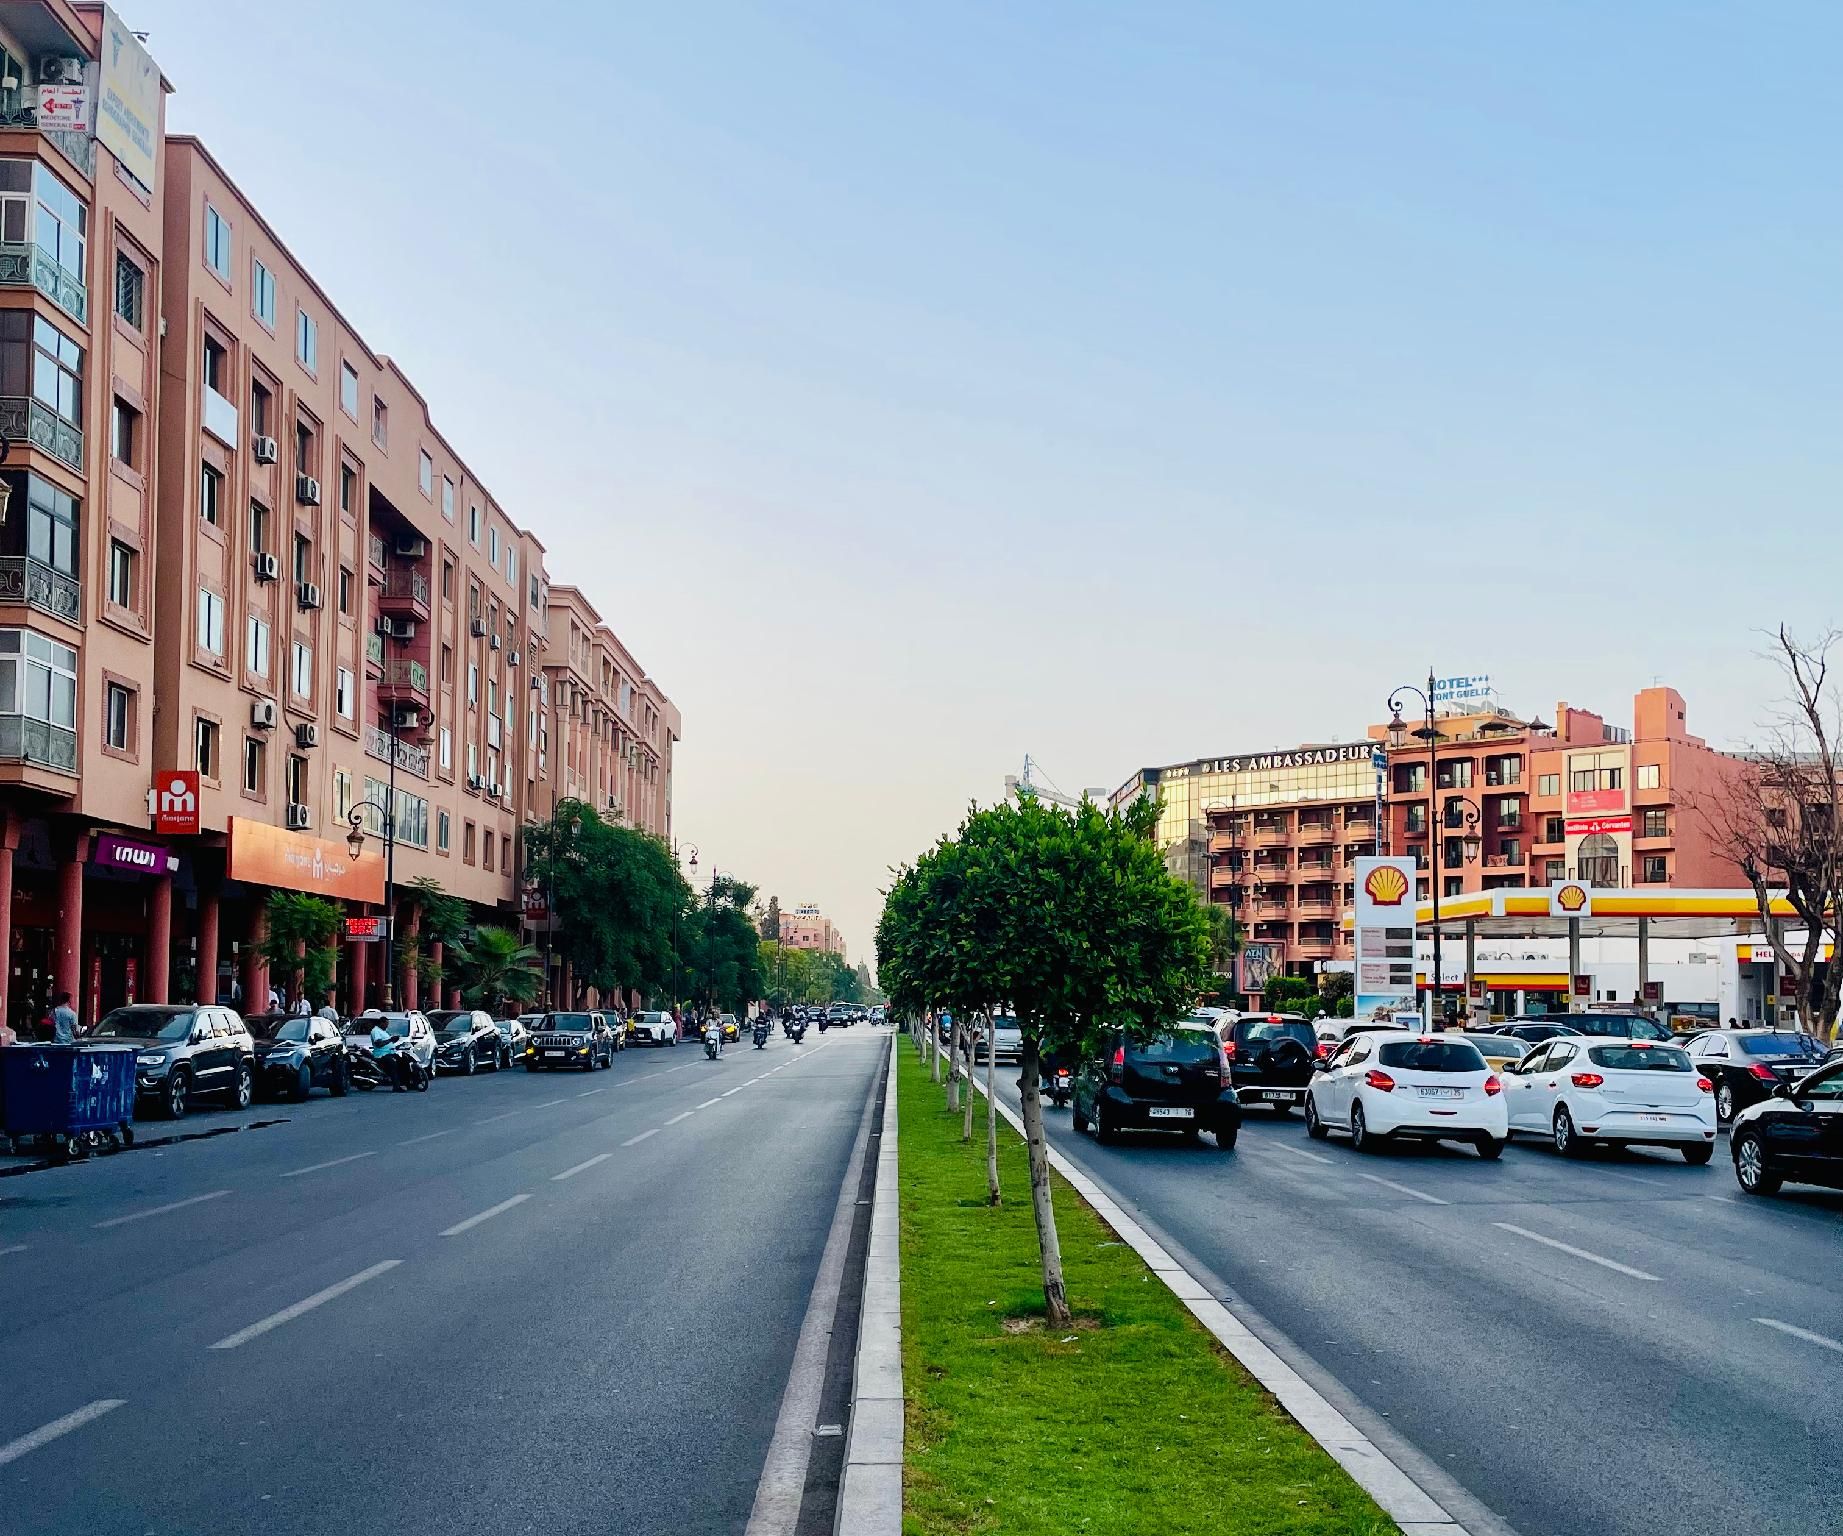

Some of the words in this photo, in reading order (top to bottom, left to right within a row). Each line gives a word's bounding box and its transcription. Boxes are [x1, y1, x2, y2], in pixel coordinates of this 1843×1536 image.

[1214, 758, 1241, 773] LES
[1249, 744, 1381, 770] AMBASSADEURS
[1430, 972, 1459, 982] Slect
